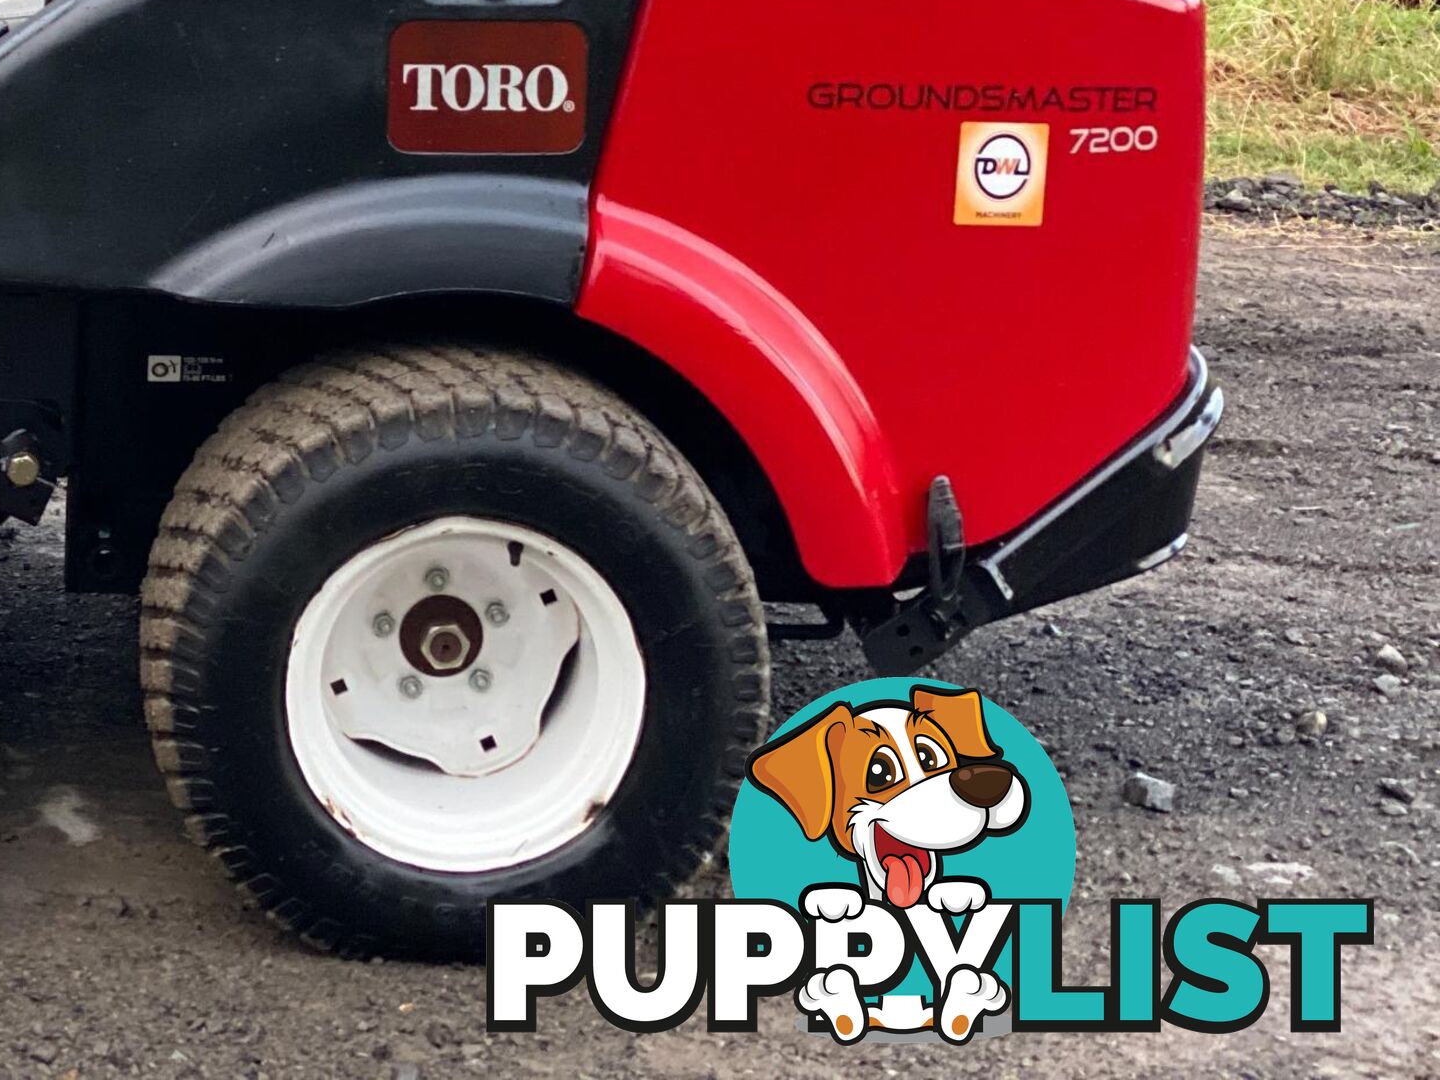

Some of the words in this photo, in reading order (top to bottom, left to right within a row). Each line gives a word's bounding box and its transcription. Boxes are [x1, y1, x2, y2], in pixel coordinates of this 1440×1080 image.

[806, 82, 1158, 112] GROUNDSMASTER
[1069, 125, 1158, 154] 7200
[975, 157, 1030, 176] DWL
[975, 211, 1022, 219] MACHINERY
